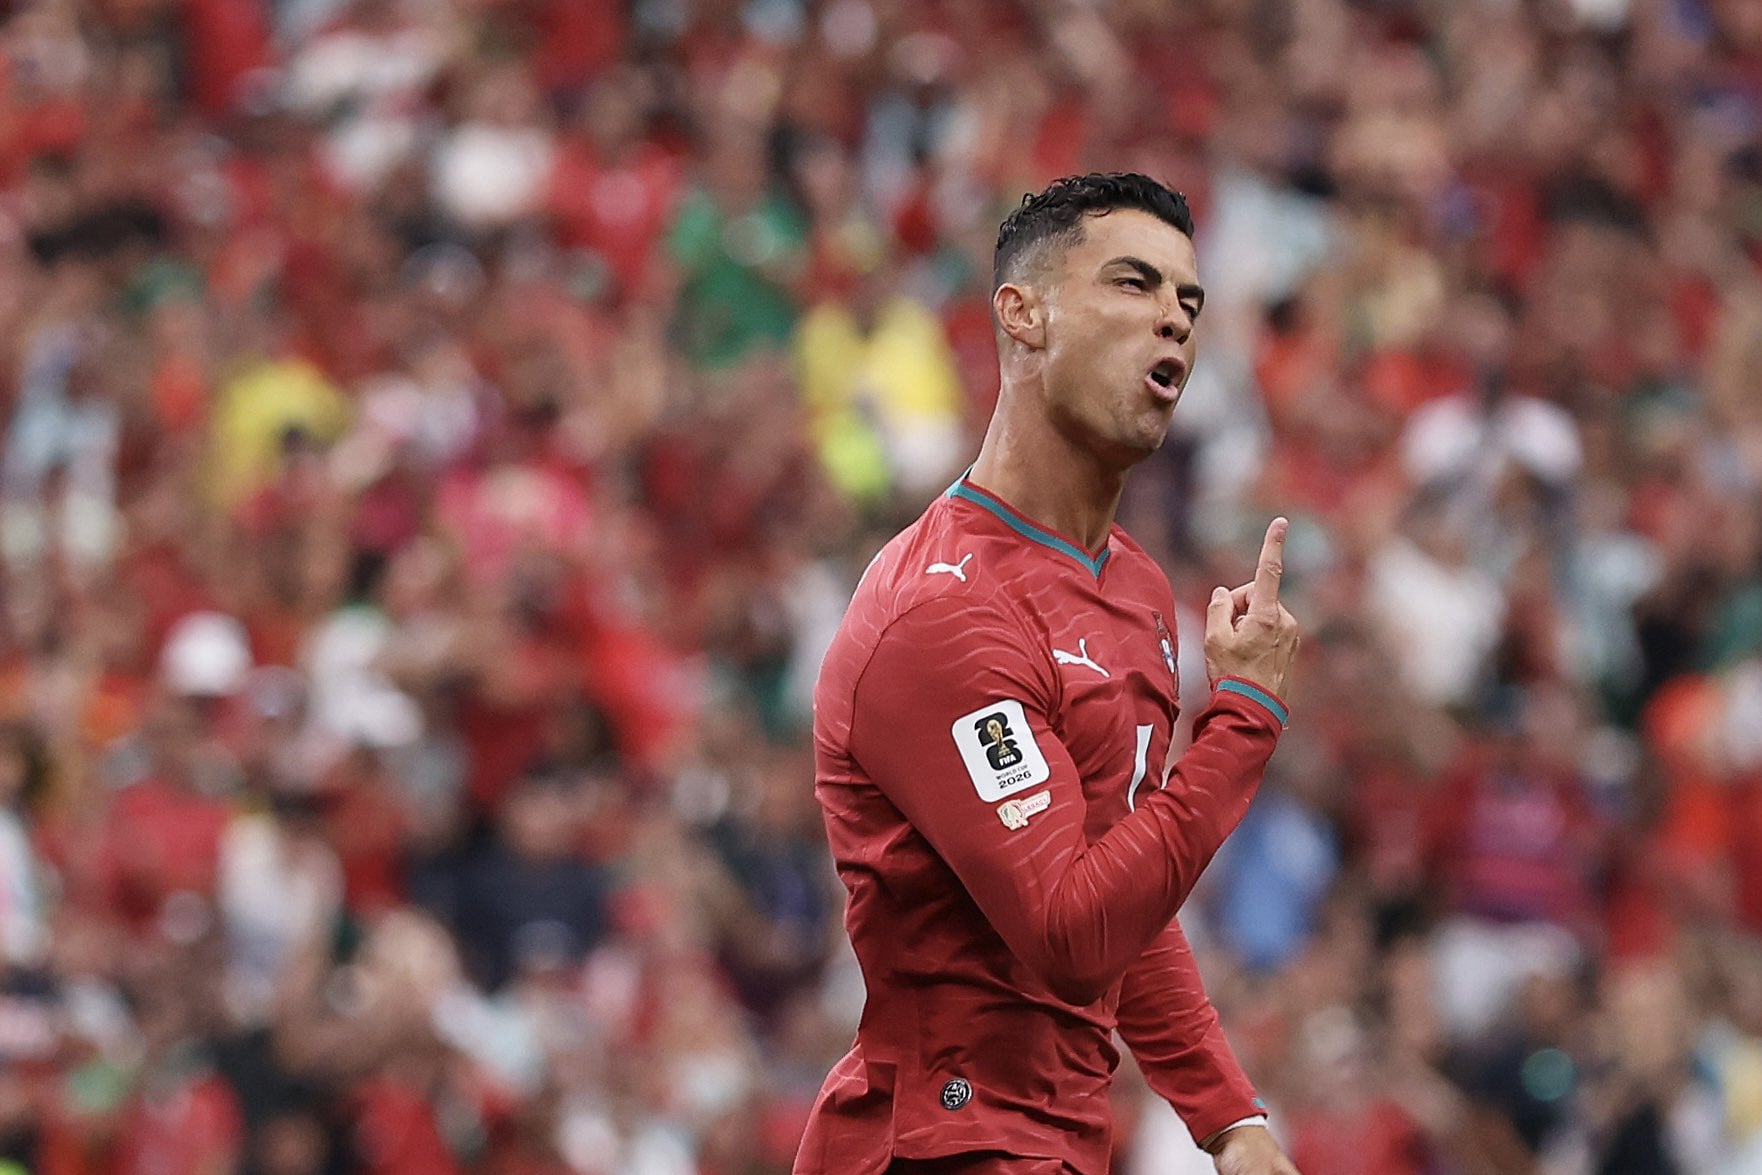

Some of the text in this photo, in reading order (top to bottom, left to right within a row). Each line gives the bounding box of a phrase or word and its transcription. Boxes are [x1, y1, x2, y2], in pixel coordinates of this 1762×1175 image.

[999, 754, 1017, 766] FIFA
[996, 764, 1028, 780] WORLD CUP
[999, 770, 1032, 789] 2026
